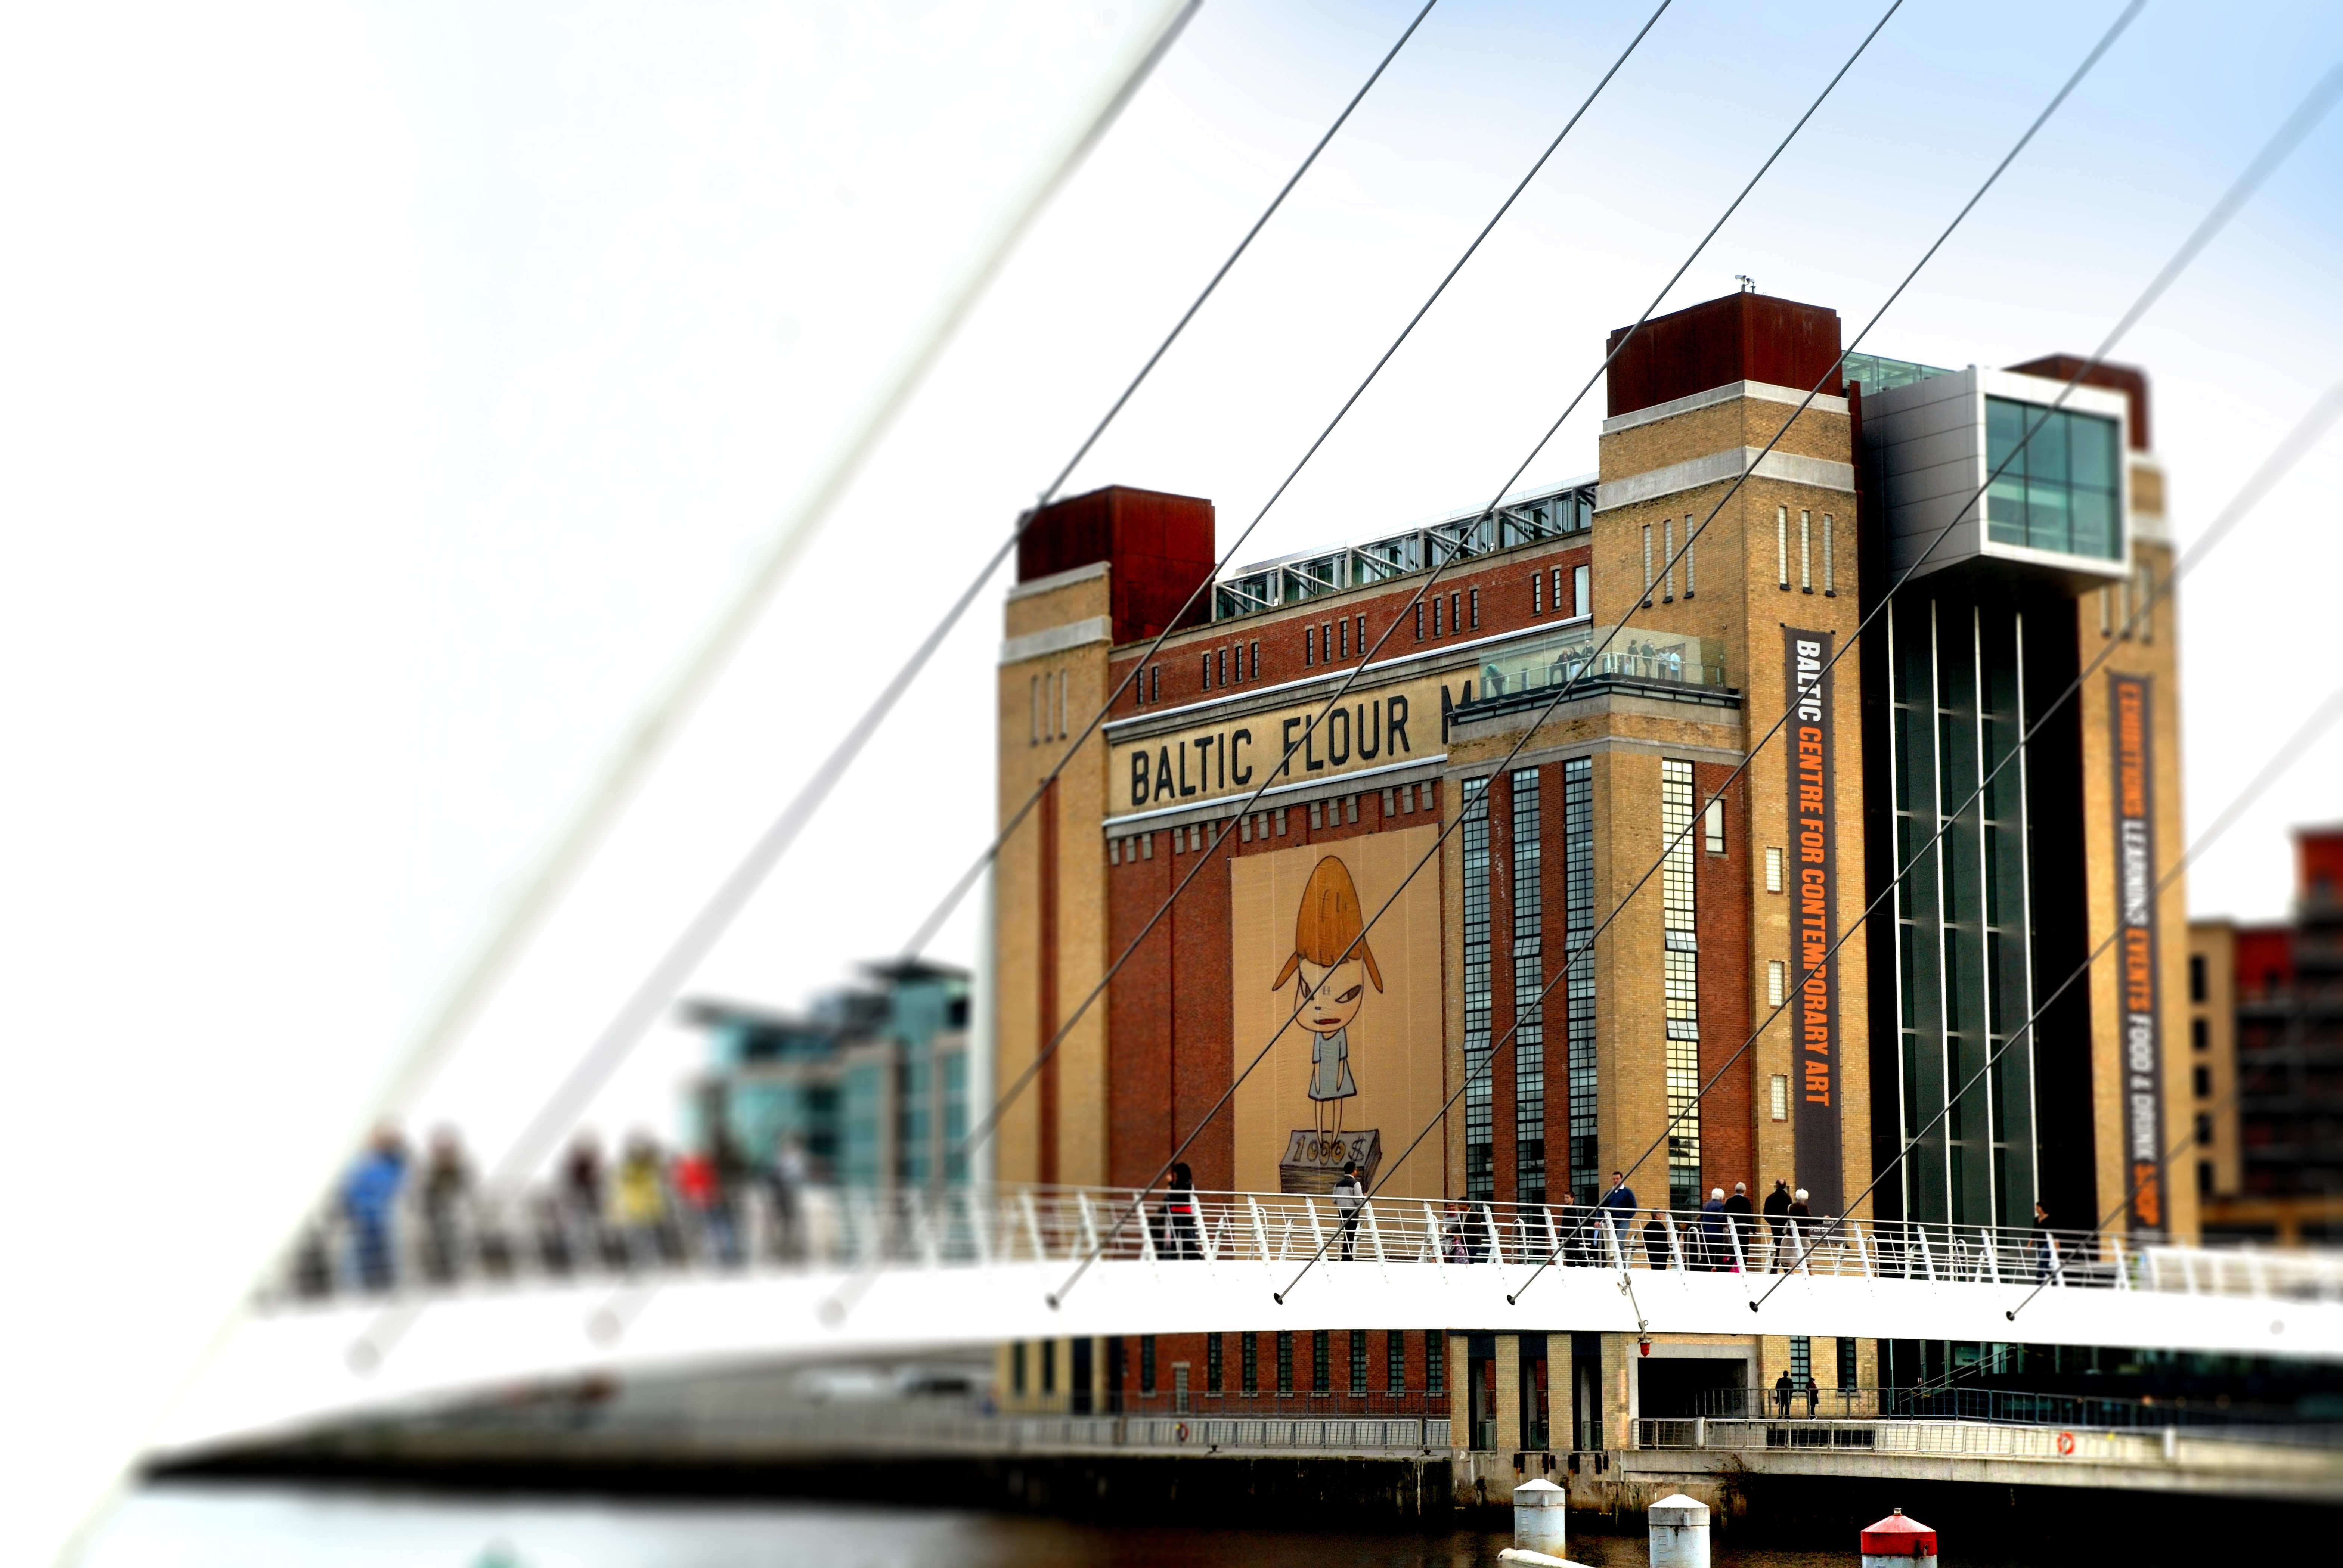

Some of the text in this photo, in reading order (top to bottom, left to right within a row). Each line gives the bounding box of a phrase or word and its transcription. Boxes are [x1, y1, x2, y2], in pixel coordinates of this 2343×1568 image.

[1131, 729, 1252, 805] BALTIC
[1283, 694, 1410, 776] FLOUR
[1797, 640, 1829, 1106] BALTIC CENTRE FOR CONTEMPORARY ART
[2125, 928, 2151, 1010] EVENTS
[2128, 1014, 2153, 1072] FOOD
[2130, 1075, 2152, 1089] &
[2131, 1093, 2156, 1160] DRINK
[2134, 1163, 2158, 1226] SHOP
